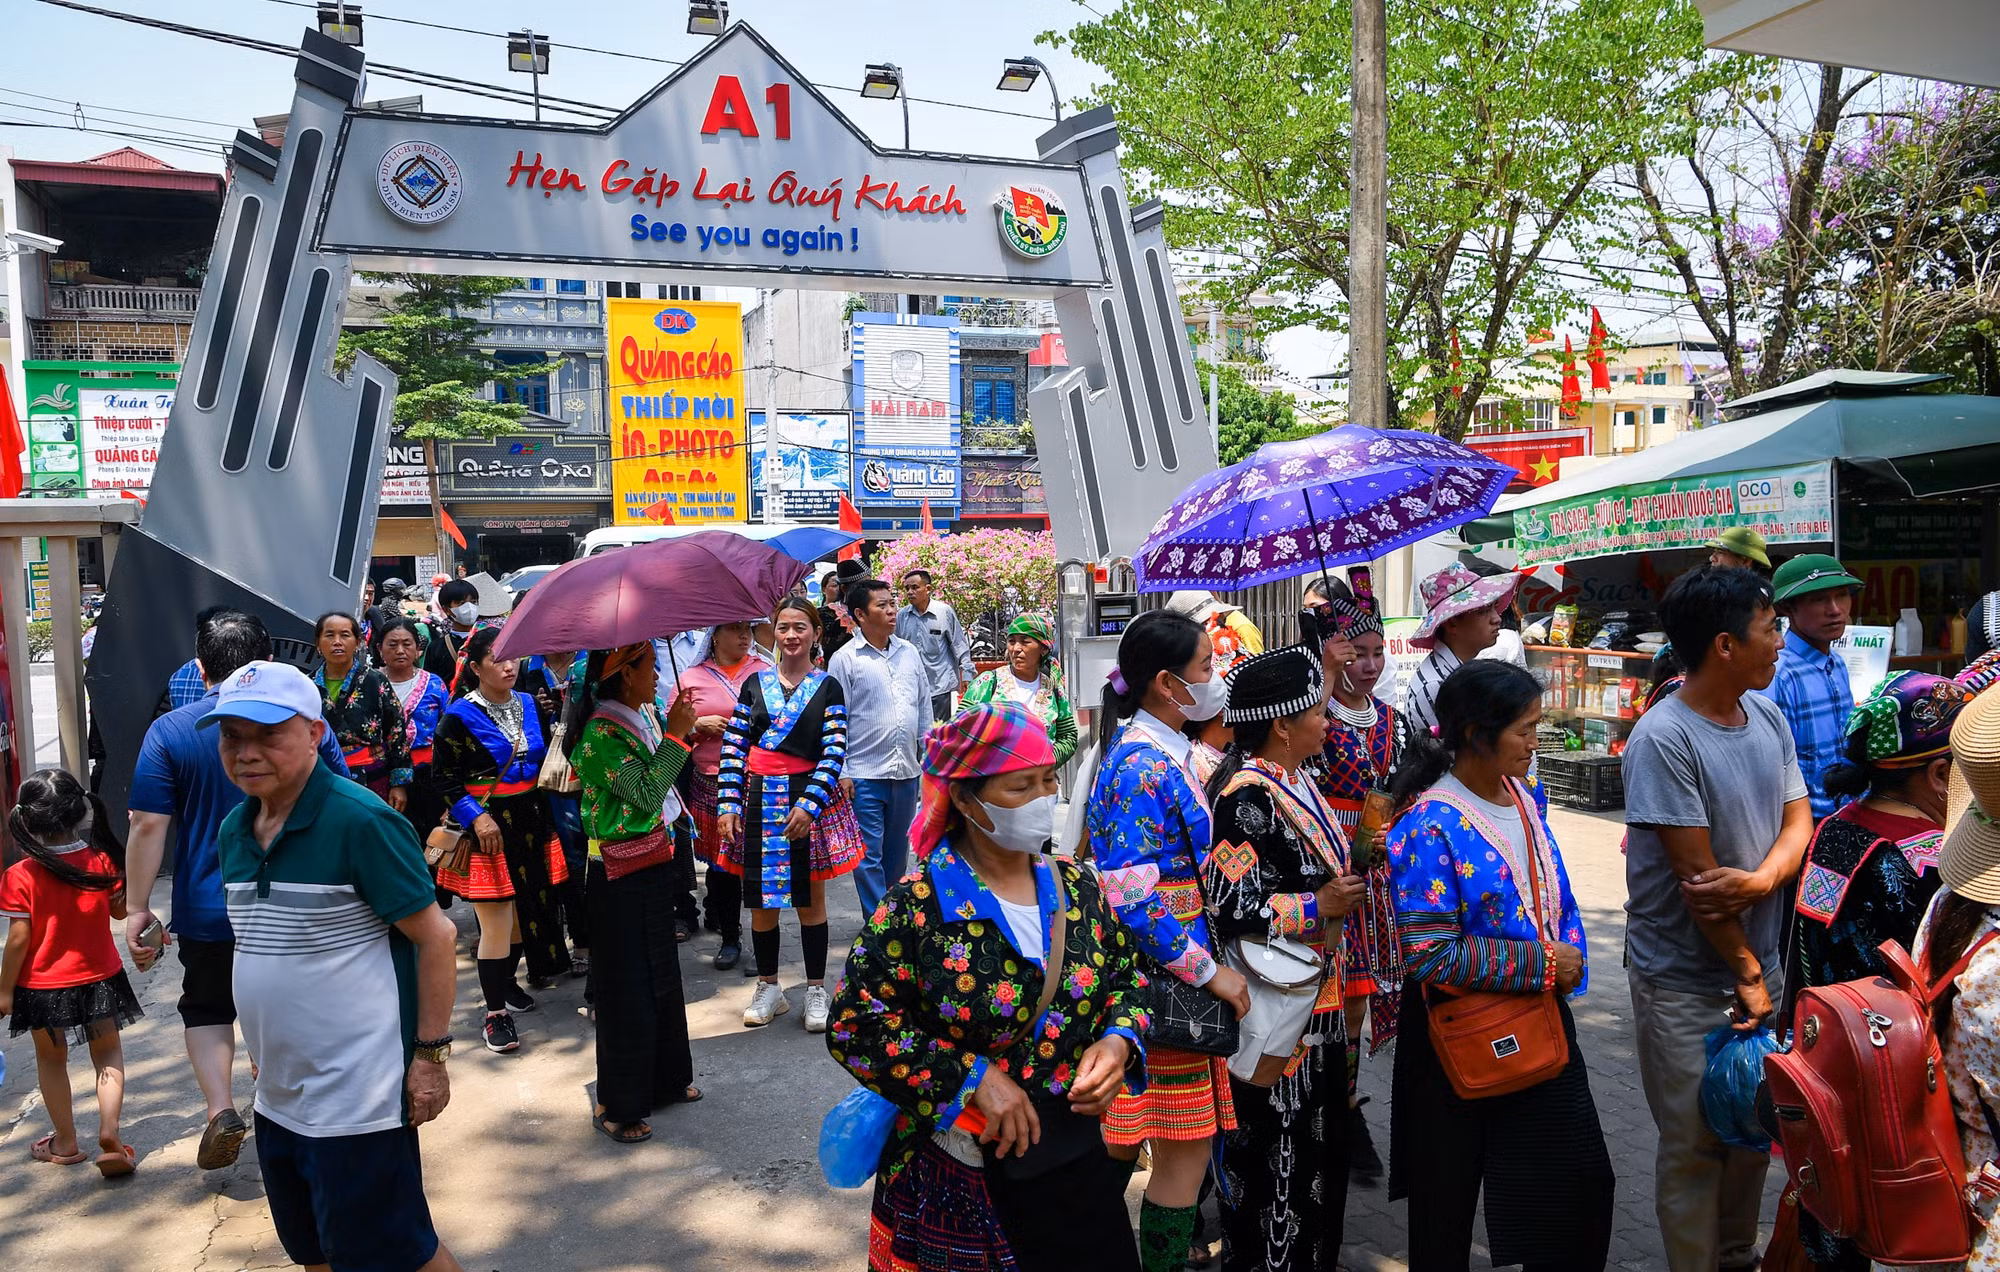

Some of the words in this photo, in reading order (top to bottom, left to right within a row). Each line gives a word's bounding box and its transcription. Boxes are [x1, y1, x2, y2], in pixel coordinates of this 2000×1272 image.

[701, 74, 791, 141] A1
[382, 163, 391, 176] DU
[506, 150, 586, 198] Hẹn
[601, 159, 680, 208] Gặp
[693, 167, 755, 209] Lại
[768, 170, 843, 221] Quý
[855, 174, 966, 215] Khách
[382, 185, 400, 209] DIEN
[399, 206, 423, 219] BIEN
[424, 190, 459, 219] TOURISM
[631, 213, 687, 243] See
[696, 224, 751, 252] you
[762, 225, 843, 255] again
[661, 313, 689, 329] DK
[1550, 507, 1567, 537] TRÀ
[1566, 506, 1590, 539] SẠCH
[1632, 496, 1650, 528] ĐẠT
[1652, 482, 1685, 521] CHUẨN
[1686, 480, 1714, 519] QUỐC
[1714, 486, 1735, 516] GIA
[1102, 621, 1117, 632] SAFE
[1853, 633, 1885, 648] NHẤT
